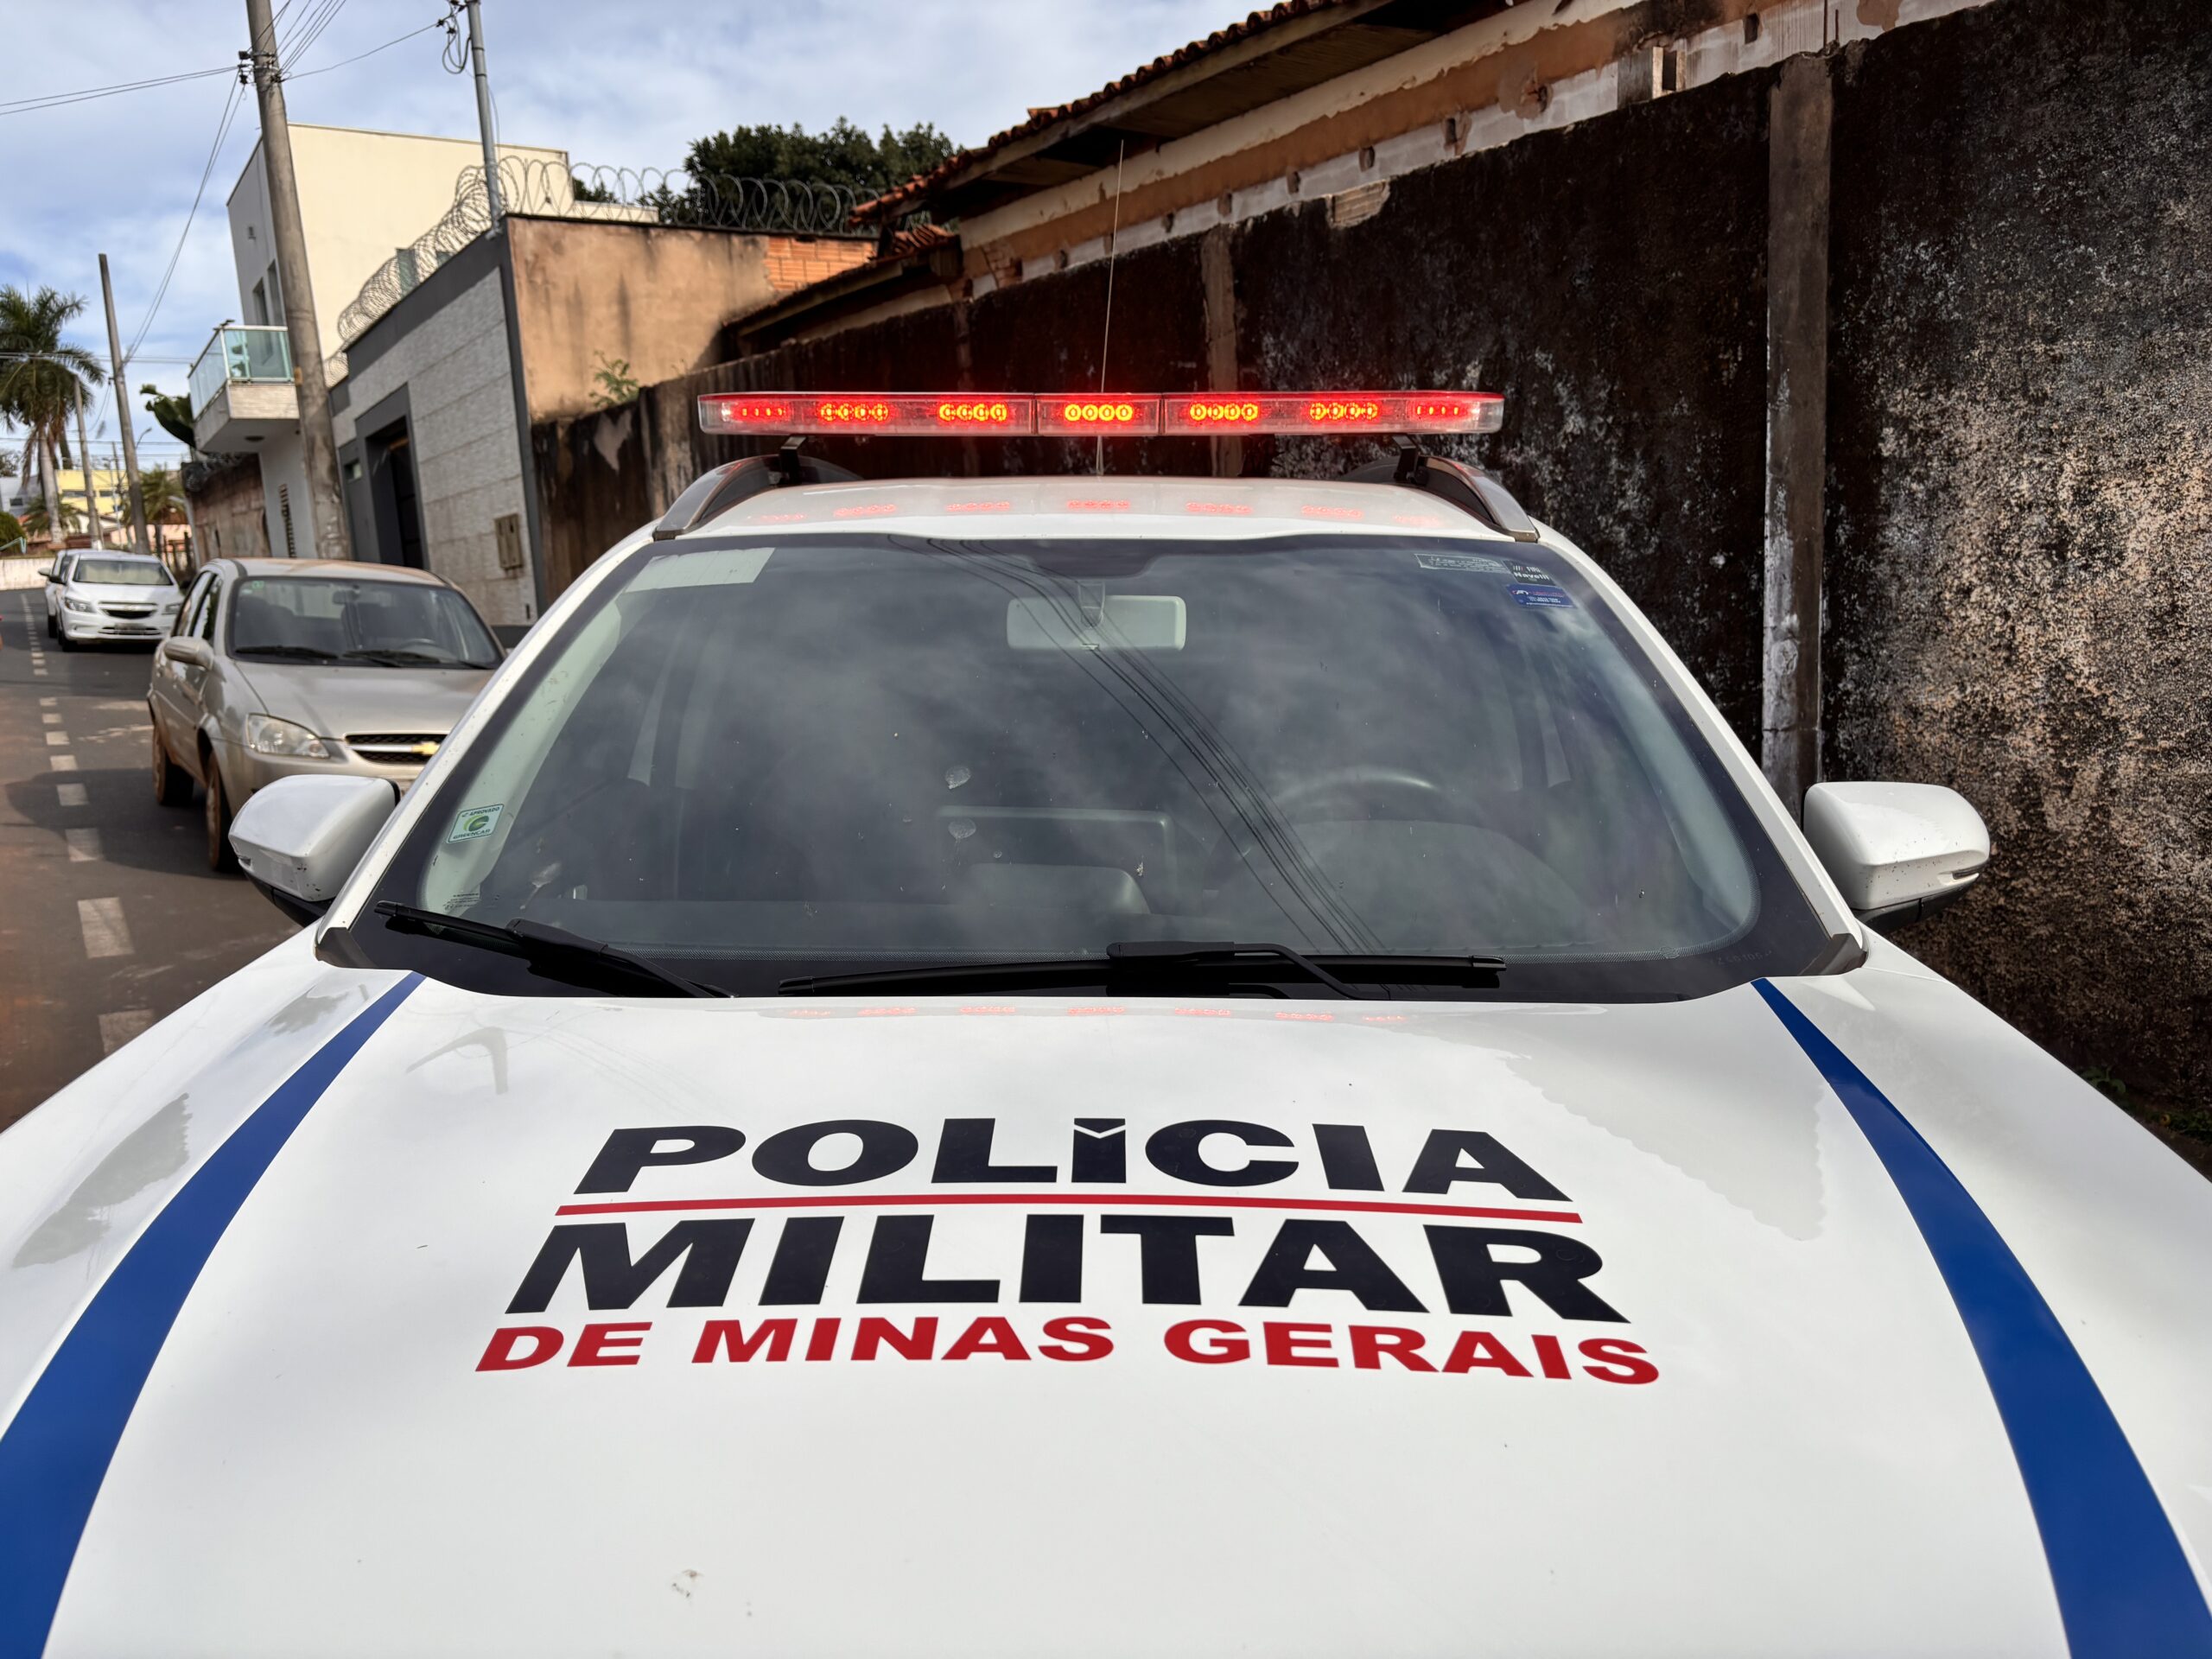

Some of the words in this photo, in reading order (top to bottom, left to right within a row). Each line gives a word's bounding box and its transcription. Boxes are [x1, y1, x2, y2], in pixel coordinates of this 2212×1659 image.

[469, 806, 500, 816] APROVADO
[453, 829, 491, 839] GREENCAR
[505, 1214, 1630, 1324] MILITAR
[476, 1322, 652, 1372] DE
[692, 1316, 1115, 1364] MINAS
[1164, 1319, 1660, 1385] GERAIS
